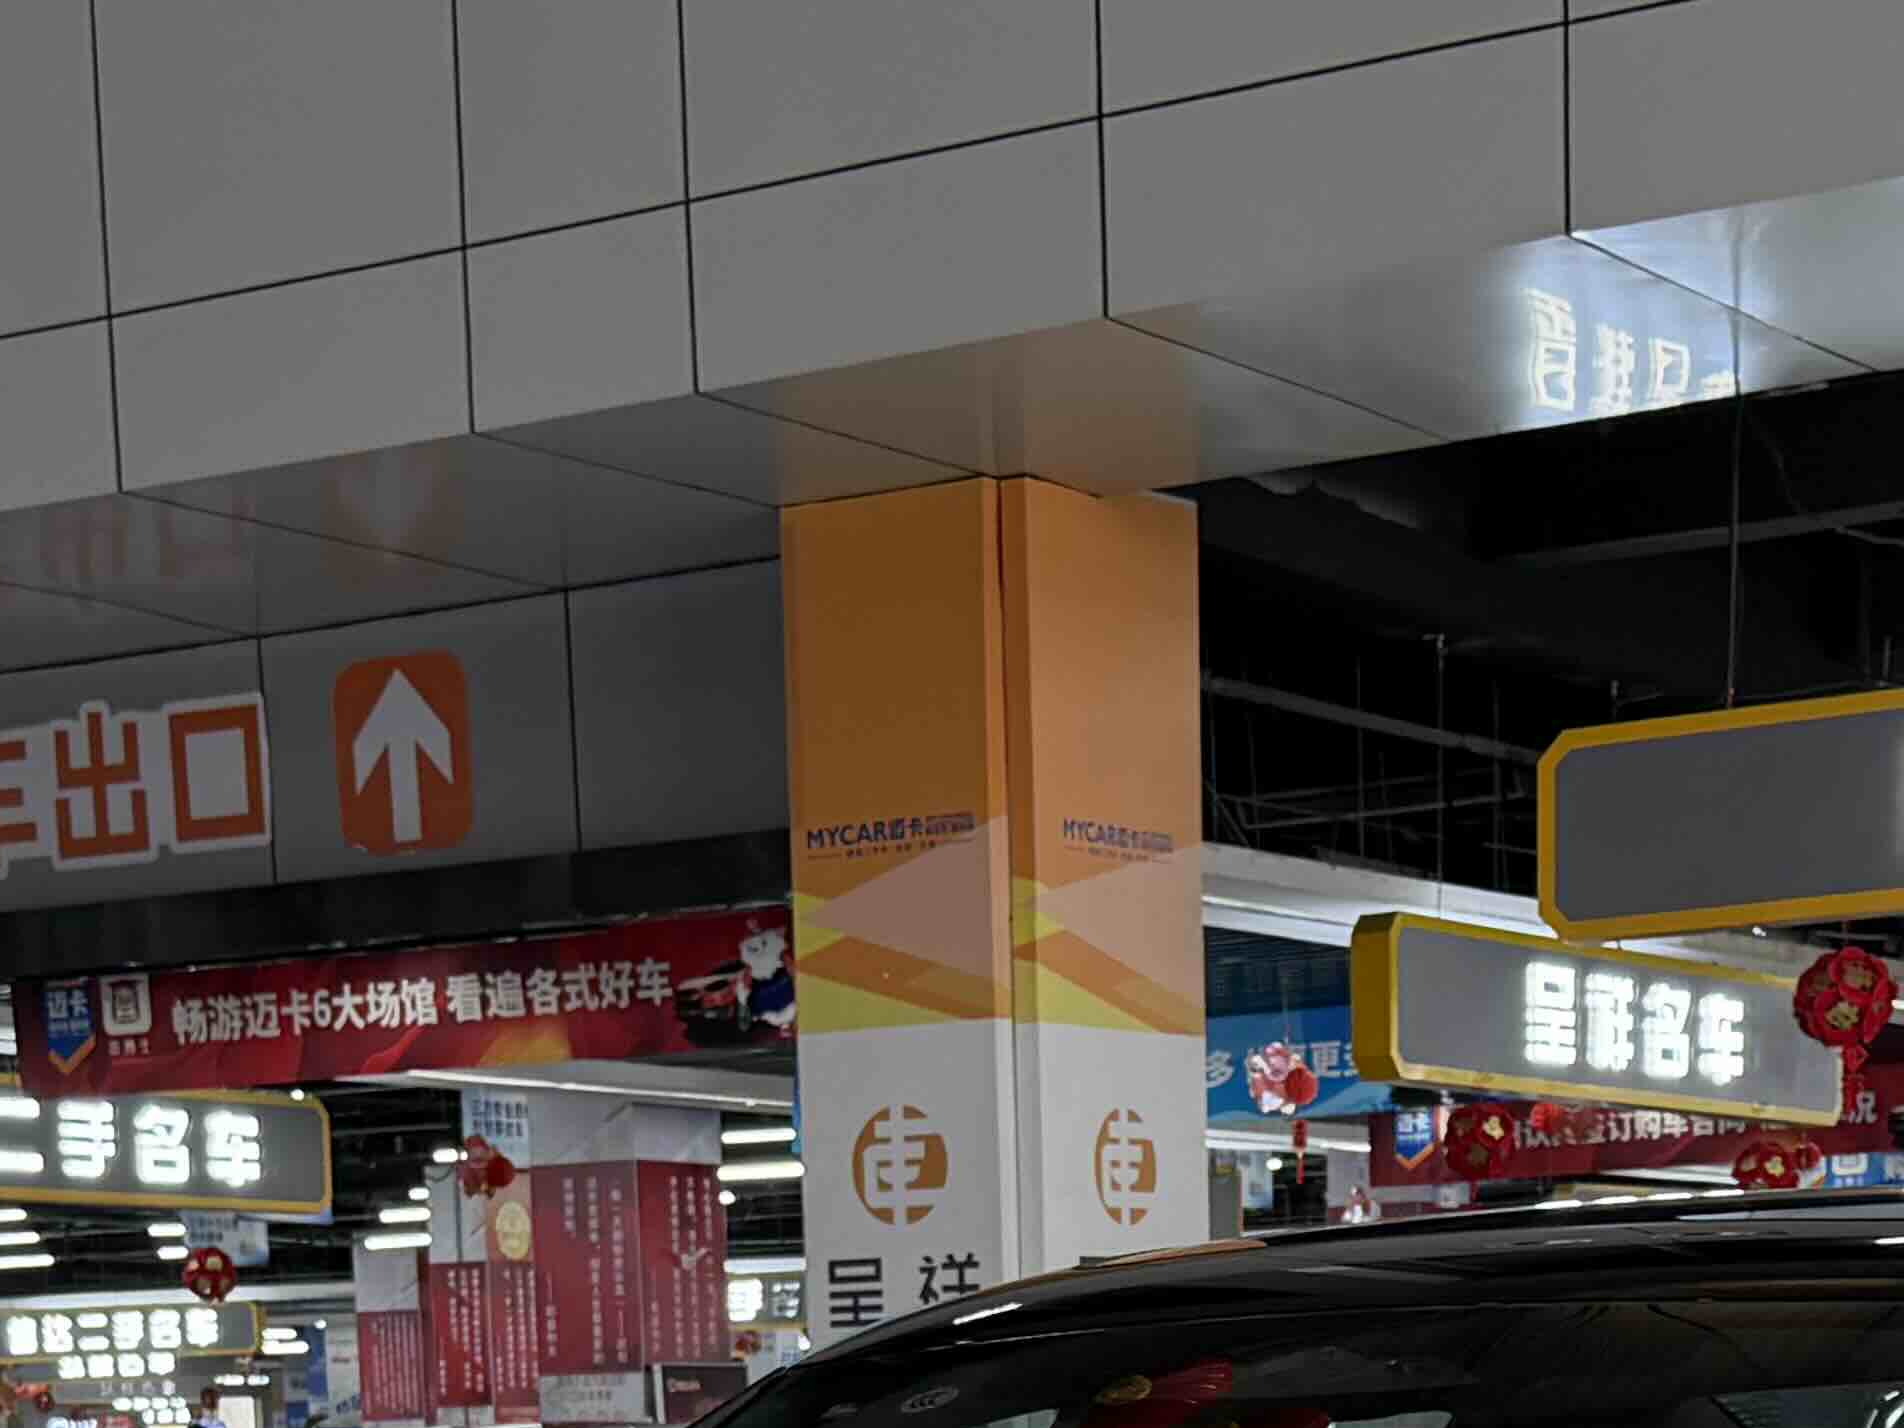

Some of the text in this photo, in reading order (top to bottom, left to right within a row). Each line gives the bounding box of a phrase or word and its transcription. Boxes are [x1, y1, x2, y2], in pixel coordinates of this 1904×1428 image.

[171, 957, 673, 1046] 畅游迈卡6大场馆 看遍各式好车
[1523, 960, 1746, 1086] 呈祥名车
[827, 1252, 981, 1329] 呈祥
